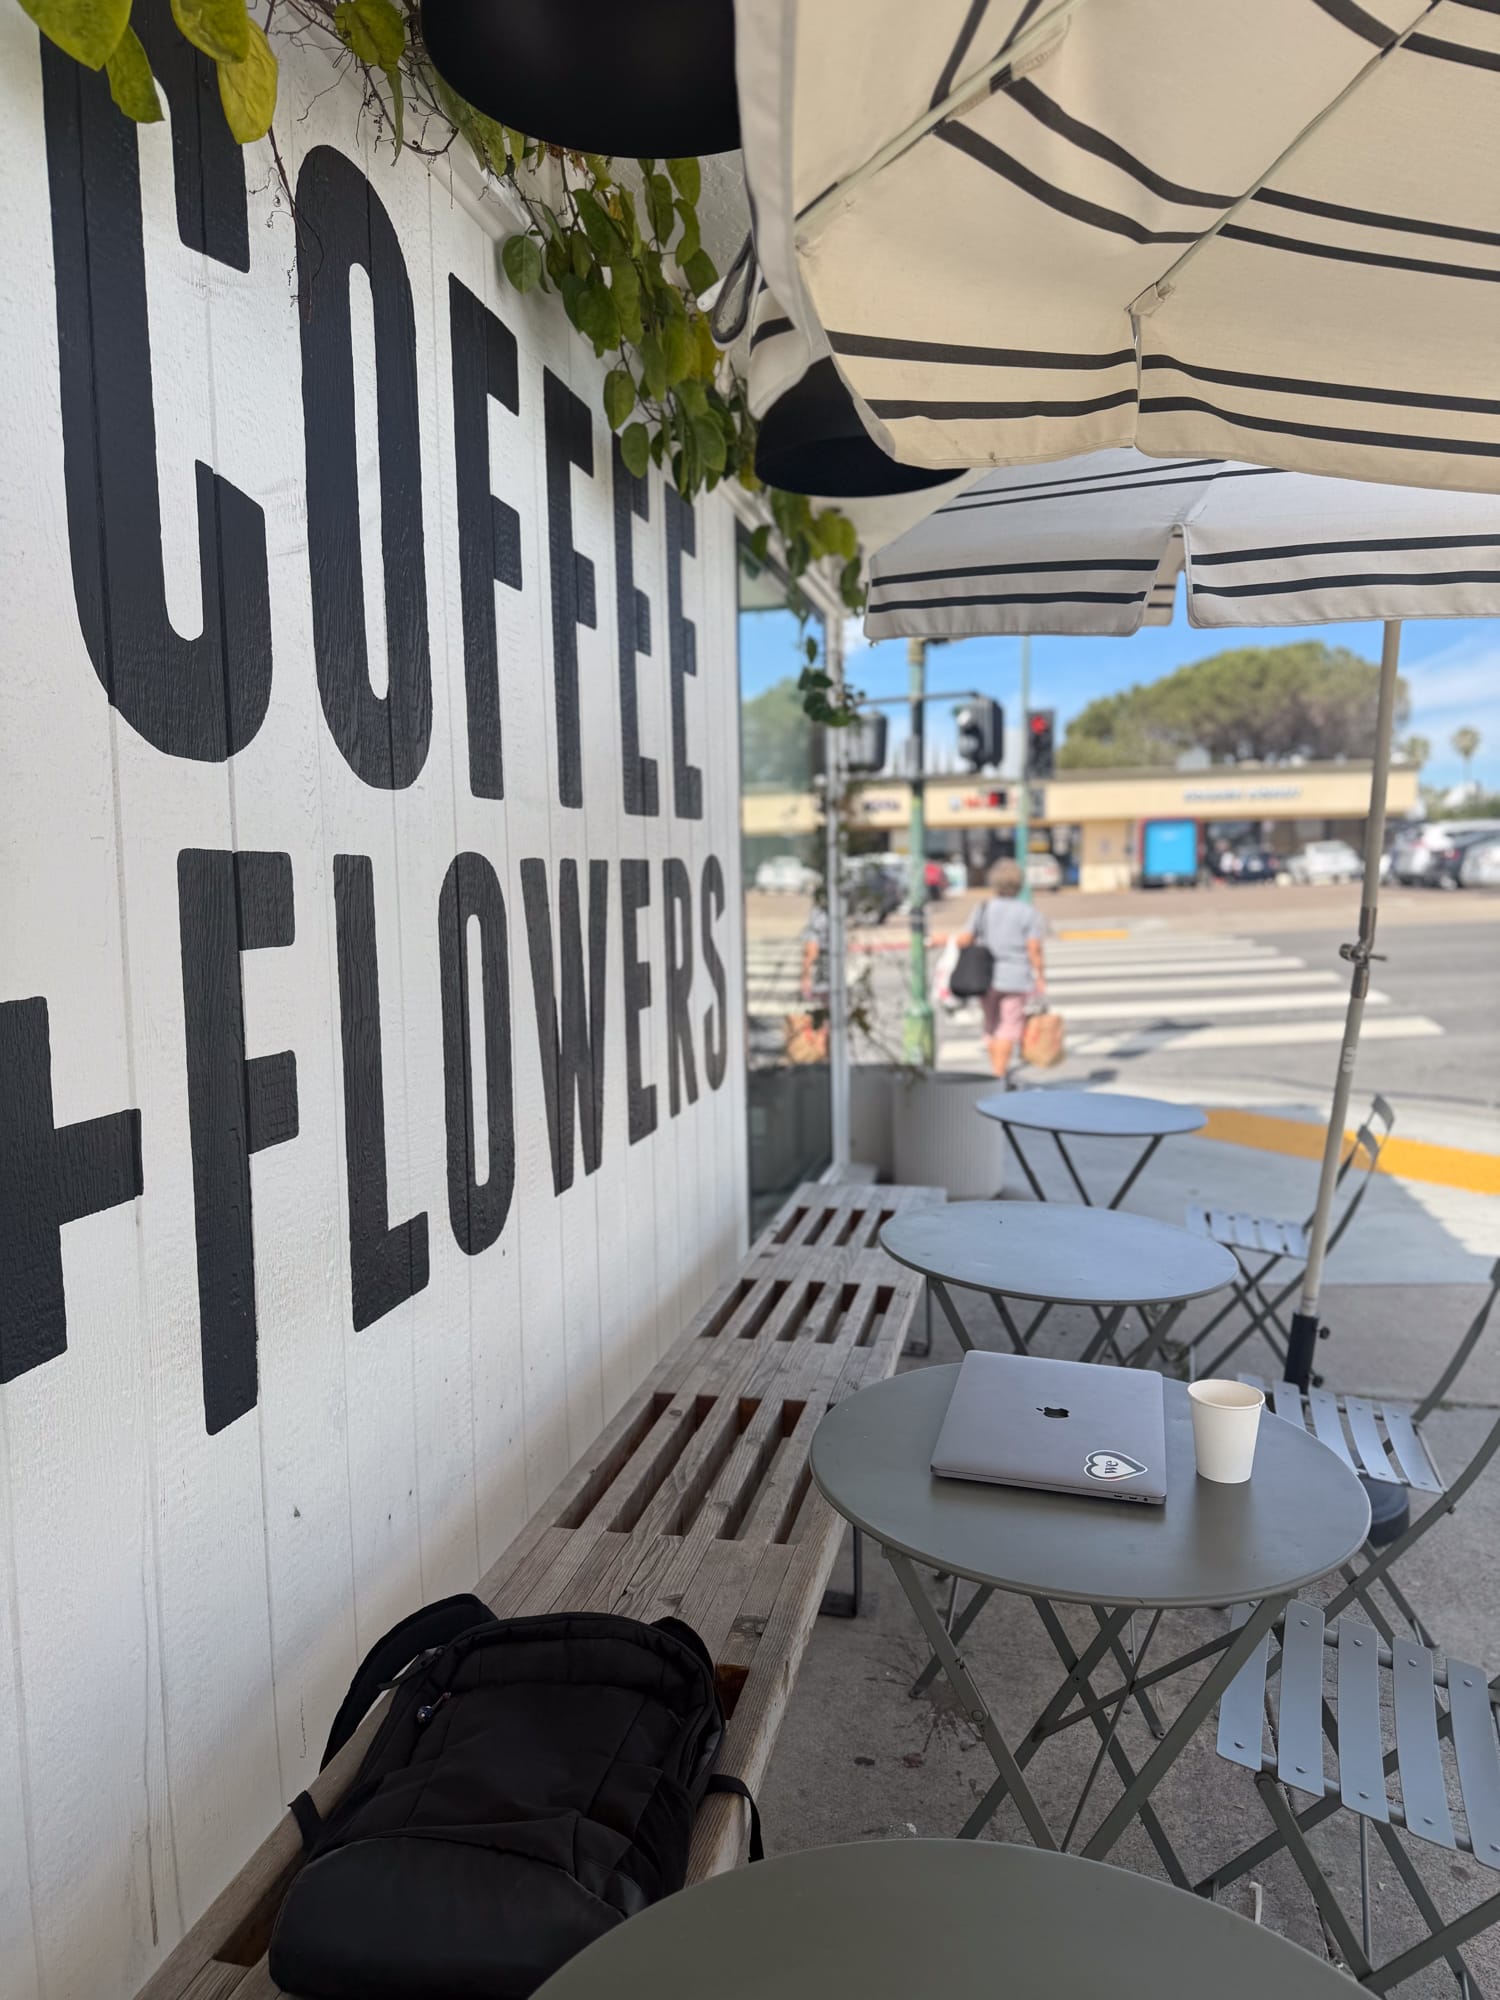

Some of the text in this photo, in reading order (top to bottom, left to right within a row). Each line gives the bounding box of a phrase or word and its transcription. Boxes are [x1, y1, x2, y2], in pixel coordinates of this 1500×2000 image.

[40, 0, 703, 821] COFFEE
[177, 848, 728, 1435] FLOWERS
[1105, 1460, 1119, 1473] we
